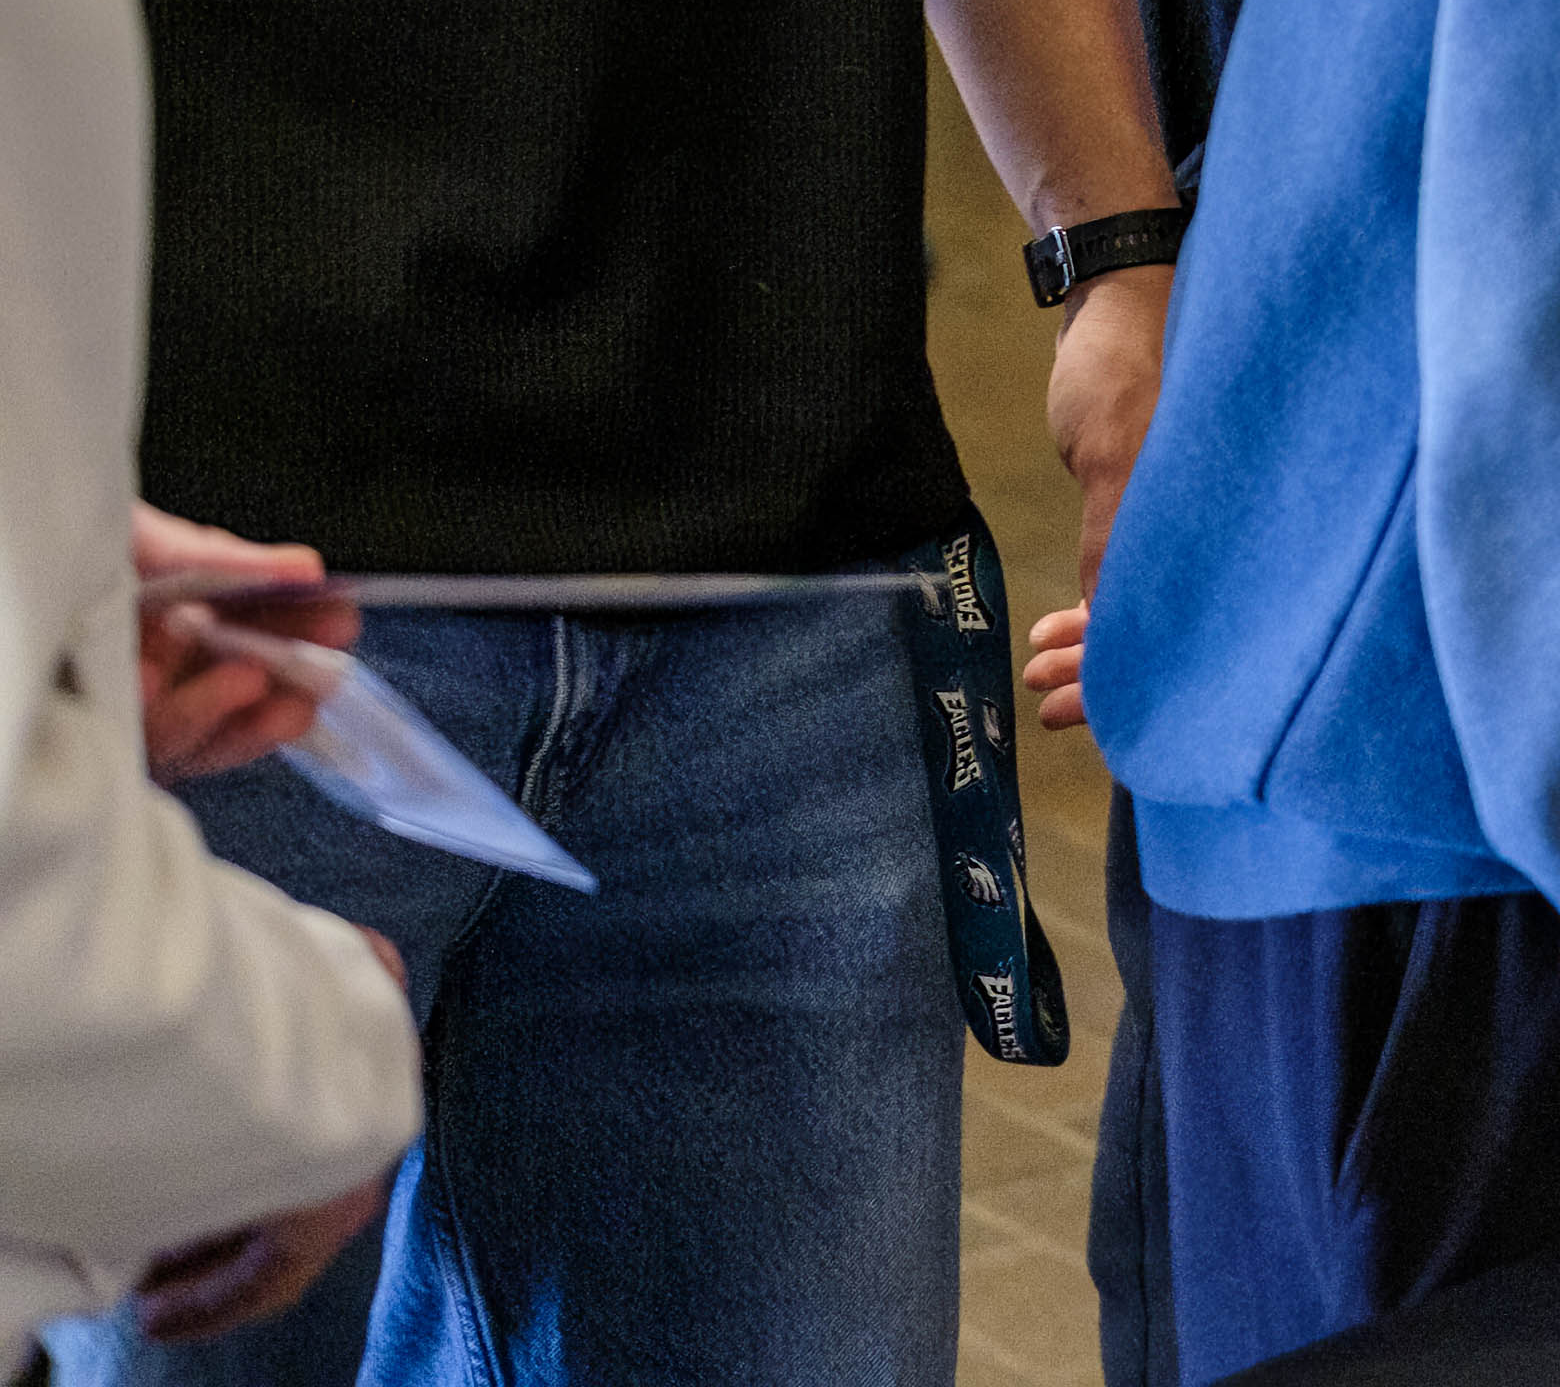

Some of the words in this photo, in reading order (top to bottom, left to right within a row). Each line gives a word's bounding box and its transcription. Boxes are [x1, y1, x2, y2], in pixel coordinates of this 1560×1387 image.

[944, 531, 992, 635] EAGLES
[935, 687, 982, 793] EAGLES
[975, 970, 1029, 1062] EAGLES
